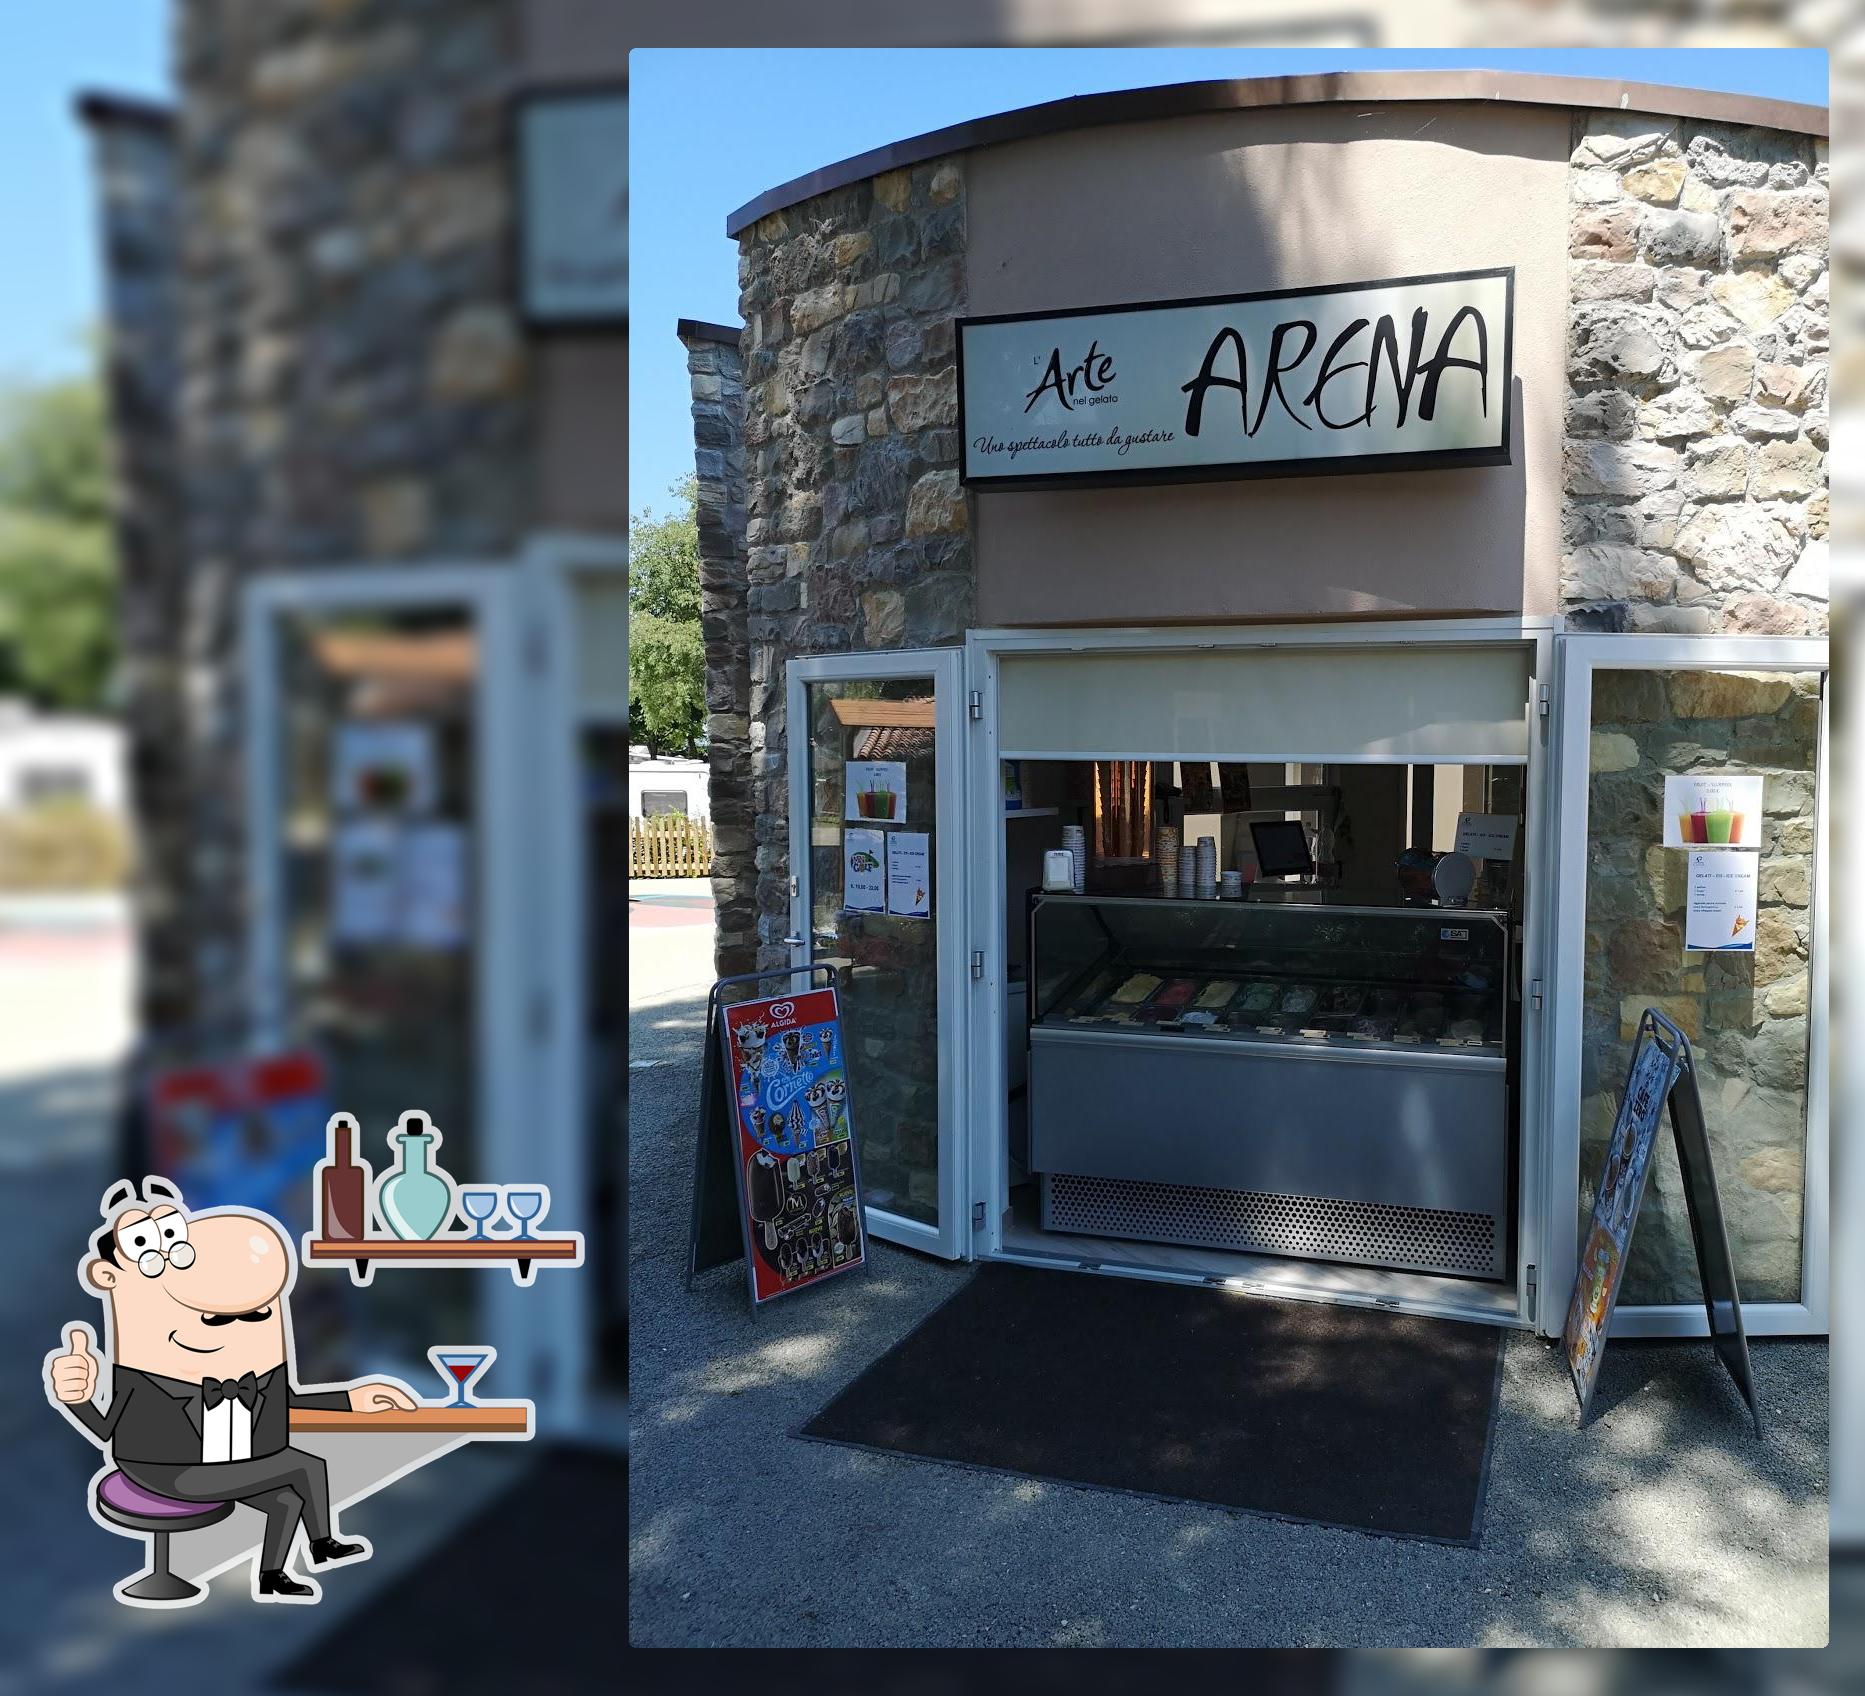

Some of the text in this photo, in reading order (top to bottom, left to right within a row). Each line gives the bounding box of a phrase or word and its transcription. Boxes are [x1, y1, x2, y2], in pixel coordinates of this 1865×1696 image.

[1023, 340, 1117, 414] Arte
[1181, 304, 1488, 438] ARENA
[1073, 392, 1119, 408] nel gelato
[973, 426, 1175, 460] Uno spettacolo tutto da gustare
[770, 1017, 796, 1029] ALGIDA
[766, 1071, 814, 1111] Cornetto
